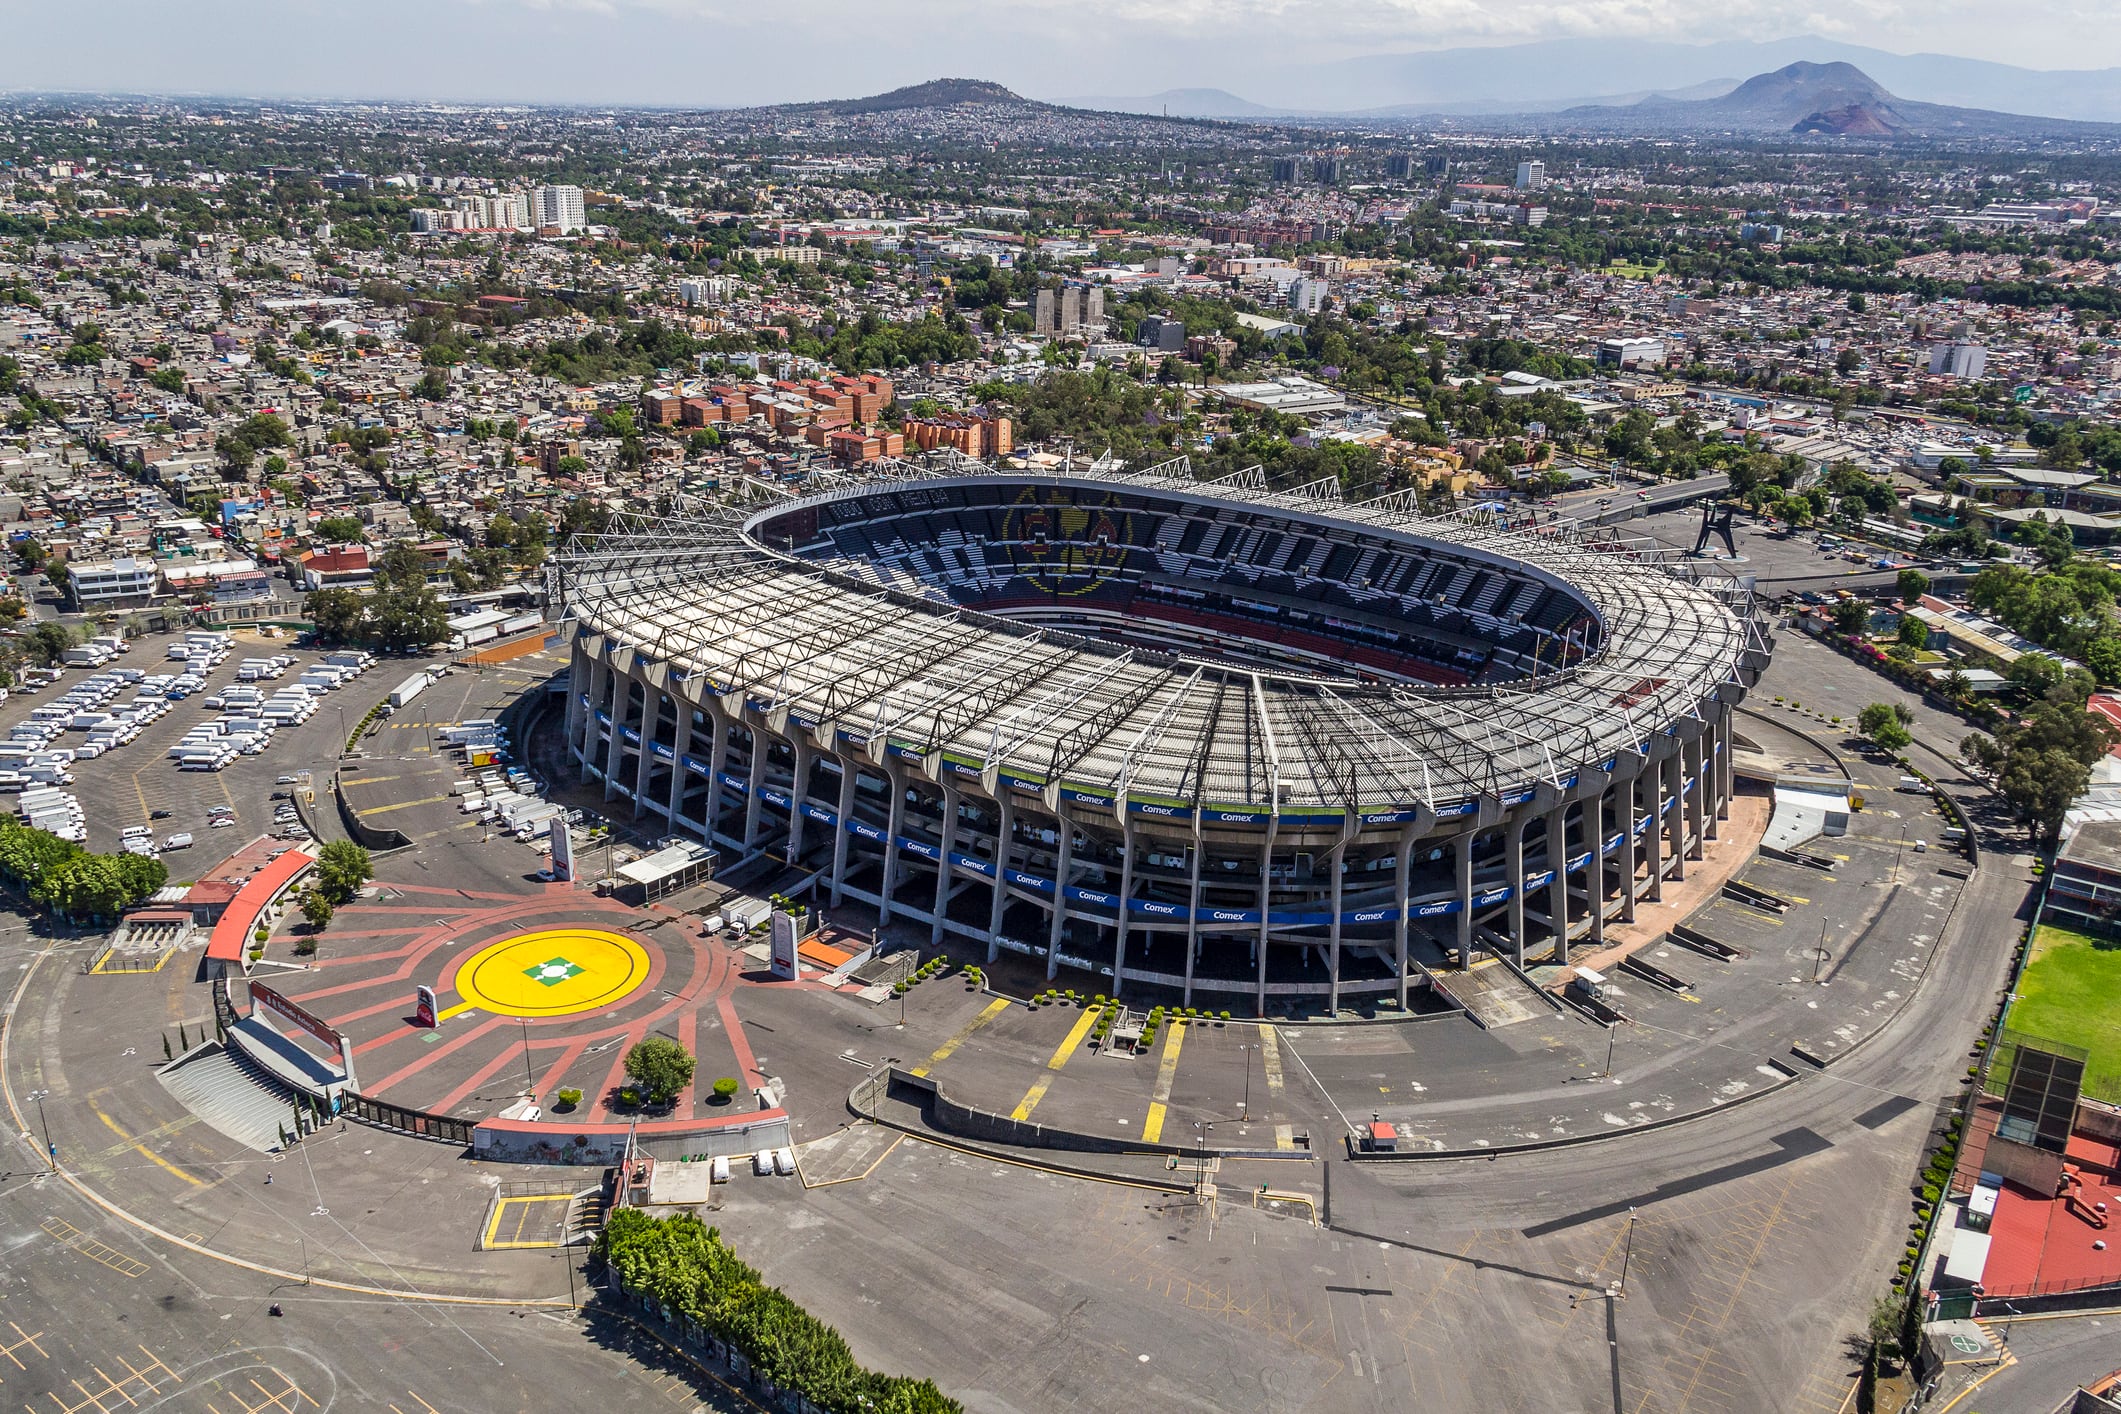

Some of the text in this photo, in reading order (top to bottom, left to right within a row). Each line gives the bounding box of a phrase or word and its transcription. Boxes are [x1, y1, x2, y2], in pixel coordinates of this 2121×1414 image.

[848, 734, 867, 745] Come
[657, 746, 674, 757] Comex
[689, 761, 706, 773] Comex
[955, 764, 982, 777] Comex
[725, 777, 744, 790] Comex
[1013, 779, 1042, 792] Comex
[765, 792, 786, 805] Comex
[1076, 793, 1106, 806] Comex
[809, 809, 831, 822] Comex
[1142, 804, 1174, 816] Comex
[1436, 806, 1464, 817] Comex
[1220, 812, 1254, 823] Comex
[1367, 813, 1399, 823] Comex
[856, 825, 880, 839] Comex
[907, 841, 932, 855] Comex
[961, 858, 987, 871] Comex
[1016, 874, 1044, 887] Comex
[1079, 890, 1108, 903] Comex
[1481, 891, 1505, 904] Comex
[1144, 902, 1175, 915] Comex
[1419, 904, 1449, 915] Comex
[1213, 911, 1246, 921] Comex
[1354, 911, 1386, 921] Comex
